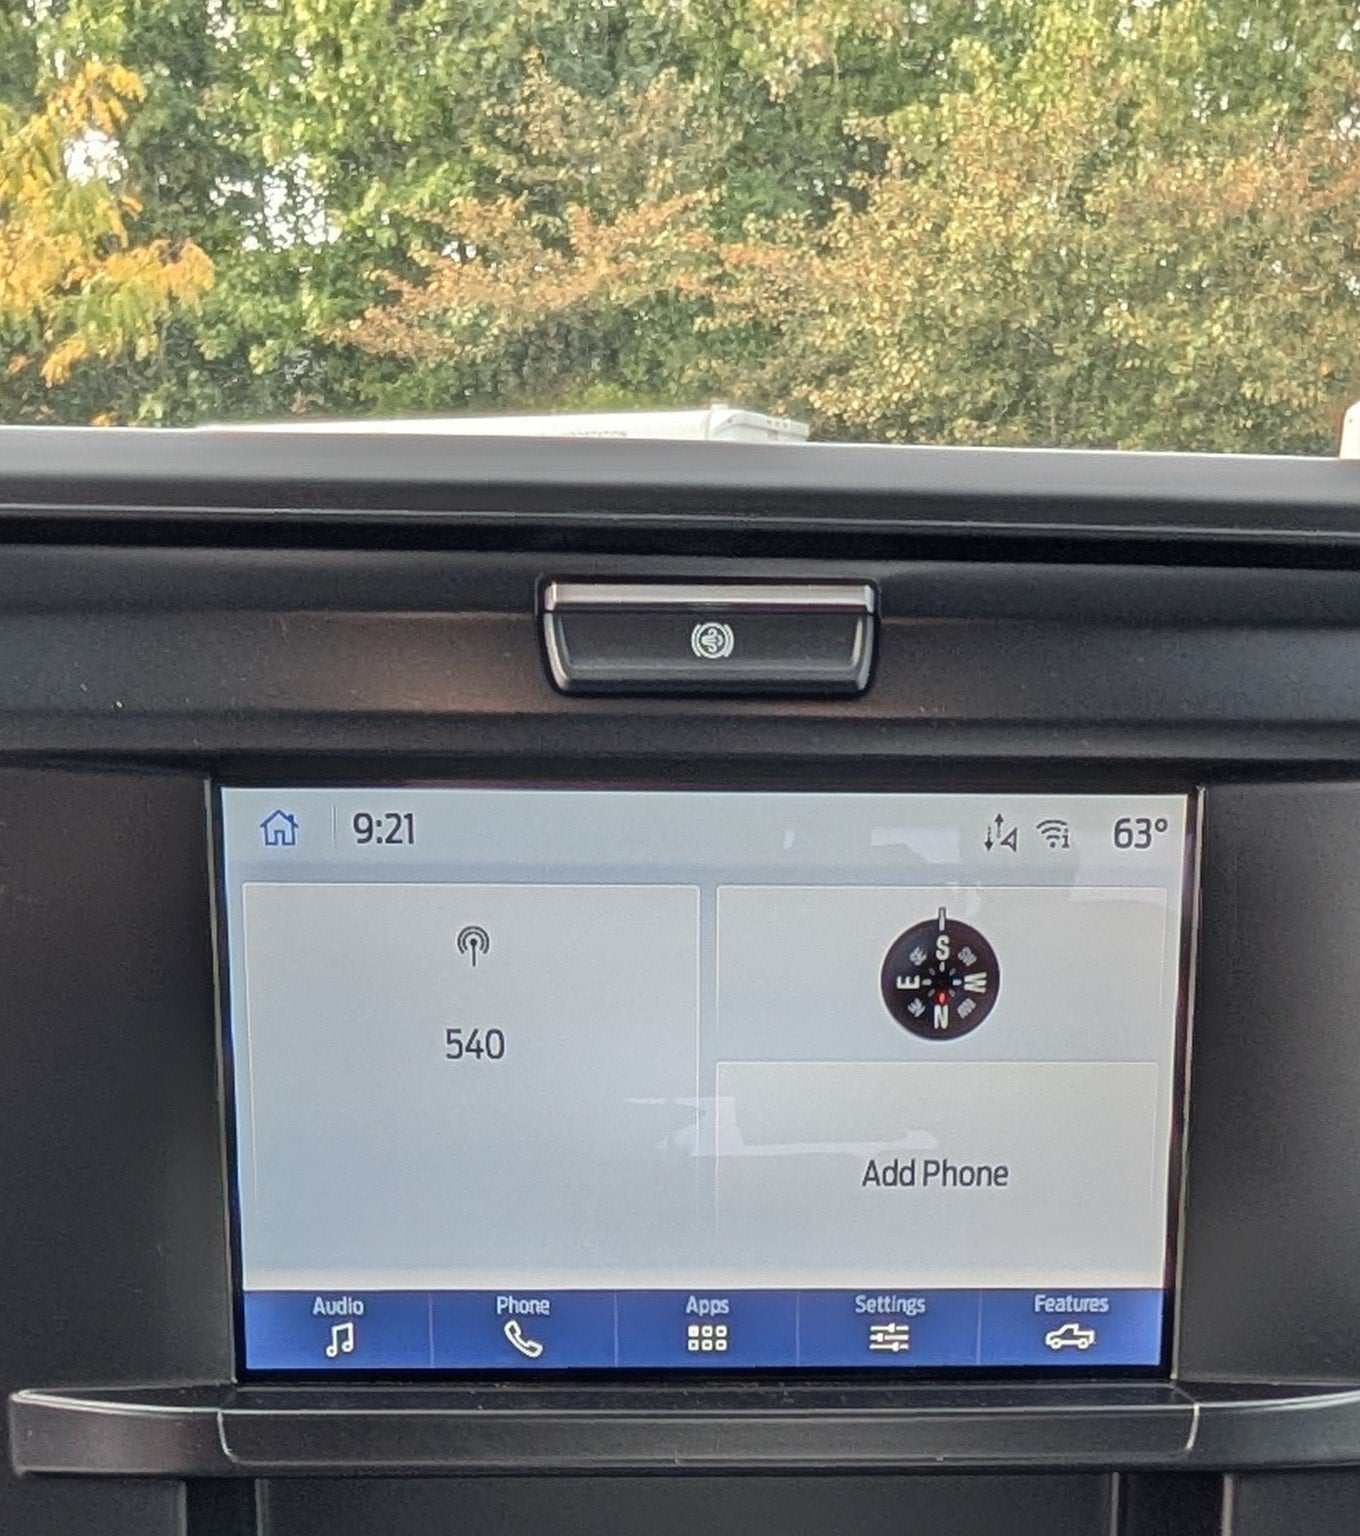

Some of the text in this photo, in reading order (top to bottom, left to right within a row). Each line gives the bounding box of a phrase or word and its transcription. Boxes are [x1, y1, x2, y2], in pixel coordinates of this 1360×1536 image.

[353, 813, 415, 844] 9:21
[1113, 817, 1169, 849] 63°
[935, 935, 950, 961] S
[445, 1028, 505, 1060] 540
[861, 1158, 1009, 1187] Add Phone
[312, 1295, 364, 1316] Audio
[496, 1295, 551, 1316] Phone
[685, 1295, 730, 1318] Apps
[855, 1294, 926, 1320] Settings
[1033, 1293, 1110, 1313] Features
